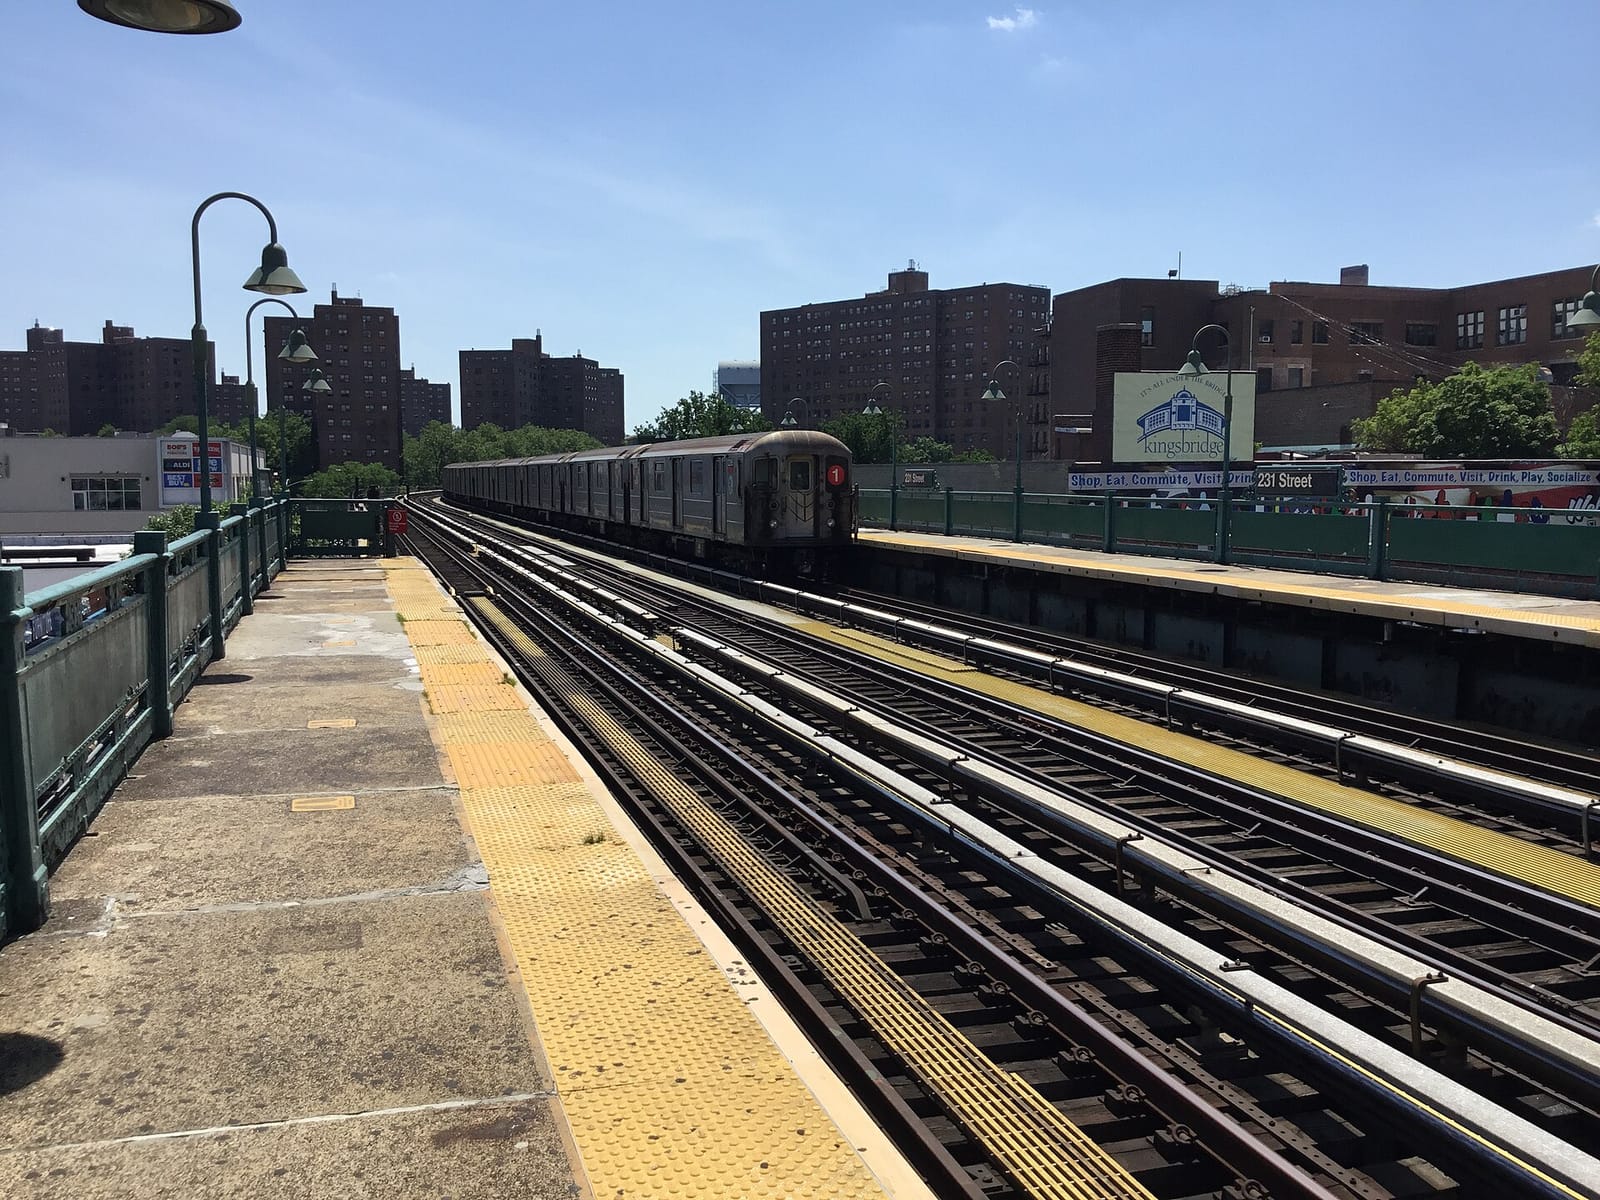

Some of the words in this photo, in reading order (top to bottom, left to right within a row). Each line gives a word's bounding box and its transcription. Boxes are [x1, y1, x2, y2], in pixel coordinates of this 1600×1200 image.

[1144, 435, 1224, 459] kingsbridge
[831, 467, 839, 482] 1
[1071, 474, 1102, 488] Shop,
[1106, 474, 1129, 487] Eat,
[1131, 473, 1191, 487] Commute,
[1257, 472, 1276, 488] 231
[1278, 472, 1313, 488] Street
[1350, 471, 1379, 484] Shop,
[1381, 471, 1401, 483] Eat,
[1404, 471, 1457, 483] Commute,
[1460, 471, 1486, 483] Visit,
[1488, 471, 1519, 483] Drink,
[1521, 471, 1545, 484] Play,
[1547, 471, 1592, 483] Socialize
